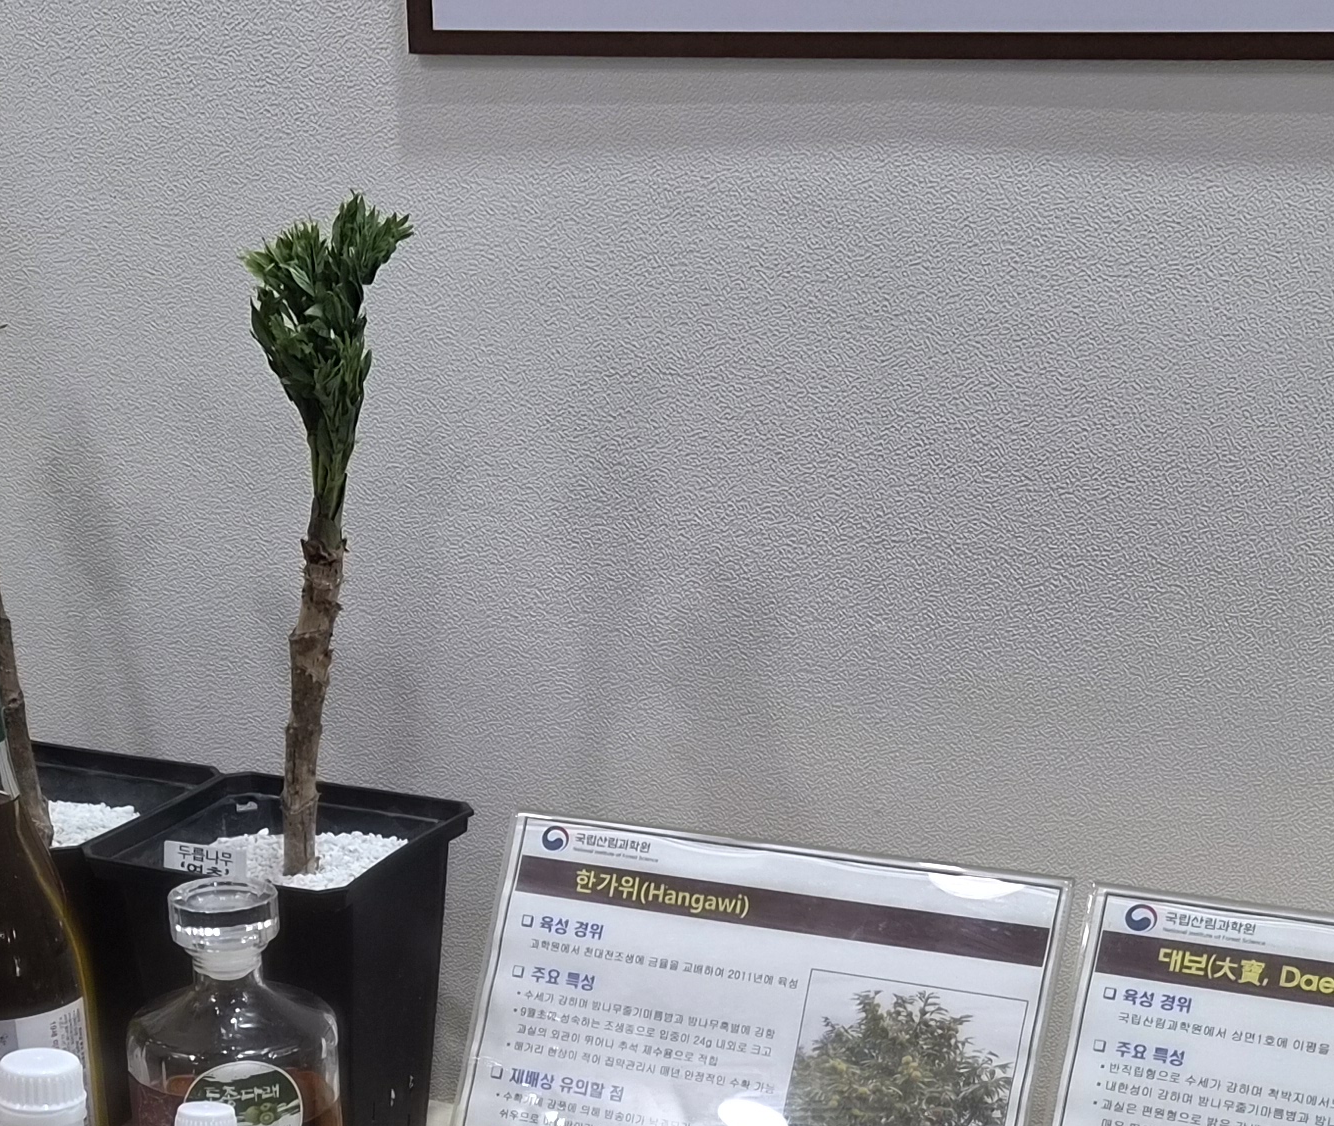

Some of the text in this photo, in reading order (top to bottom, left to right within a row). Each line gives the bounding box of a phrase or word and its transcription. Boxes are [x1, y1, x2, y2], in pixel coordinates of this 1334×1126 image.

[574, 830, 651, 854] 국립산림과학원
[576, 866, 749, 919] 한가위(Hangawi)
[540, 915, 604, 941] 육성 경위
[1165, 910, 1258, 936] 국립산림과학원
[530, 966, 596, 992] 주요 특성
[1123, 988, 1193, 1014] 육성 경위
[1118, 1011, 1227, 1039] 국립산림과학원에서
[1115, 1041, 1186, 1067] 주요 특성
[508, 1067, 625, 1103] 재배상 유의할 점
[1105, 1080, 1194, 1105] 내한성이 강하며
[1109, 1062, 1181, 1084] 반직립형으로
[1184, 1074, 1222, 1091] 수세가
[1226, 1081, 1263, 1098] 강하며
[204, 1083, 280, 1108] 토종다래
[1101, 1098, 1137, 1115] 과실은
[1141, 1105, 1202, 1126] 편원형으로
